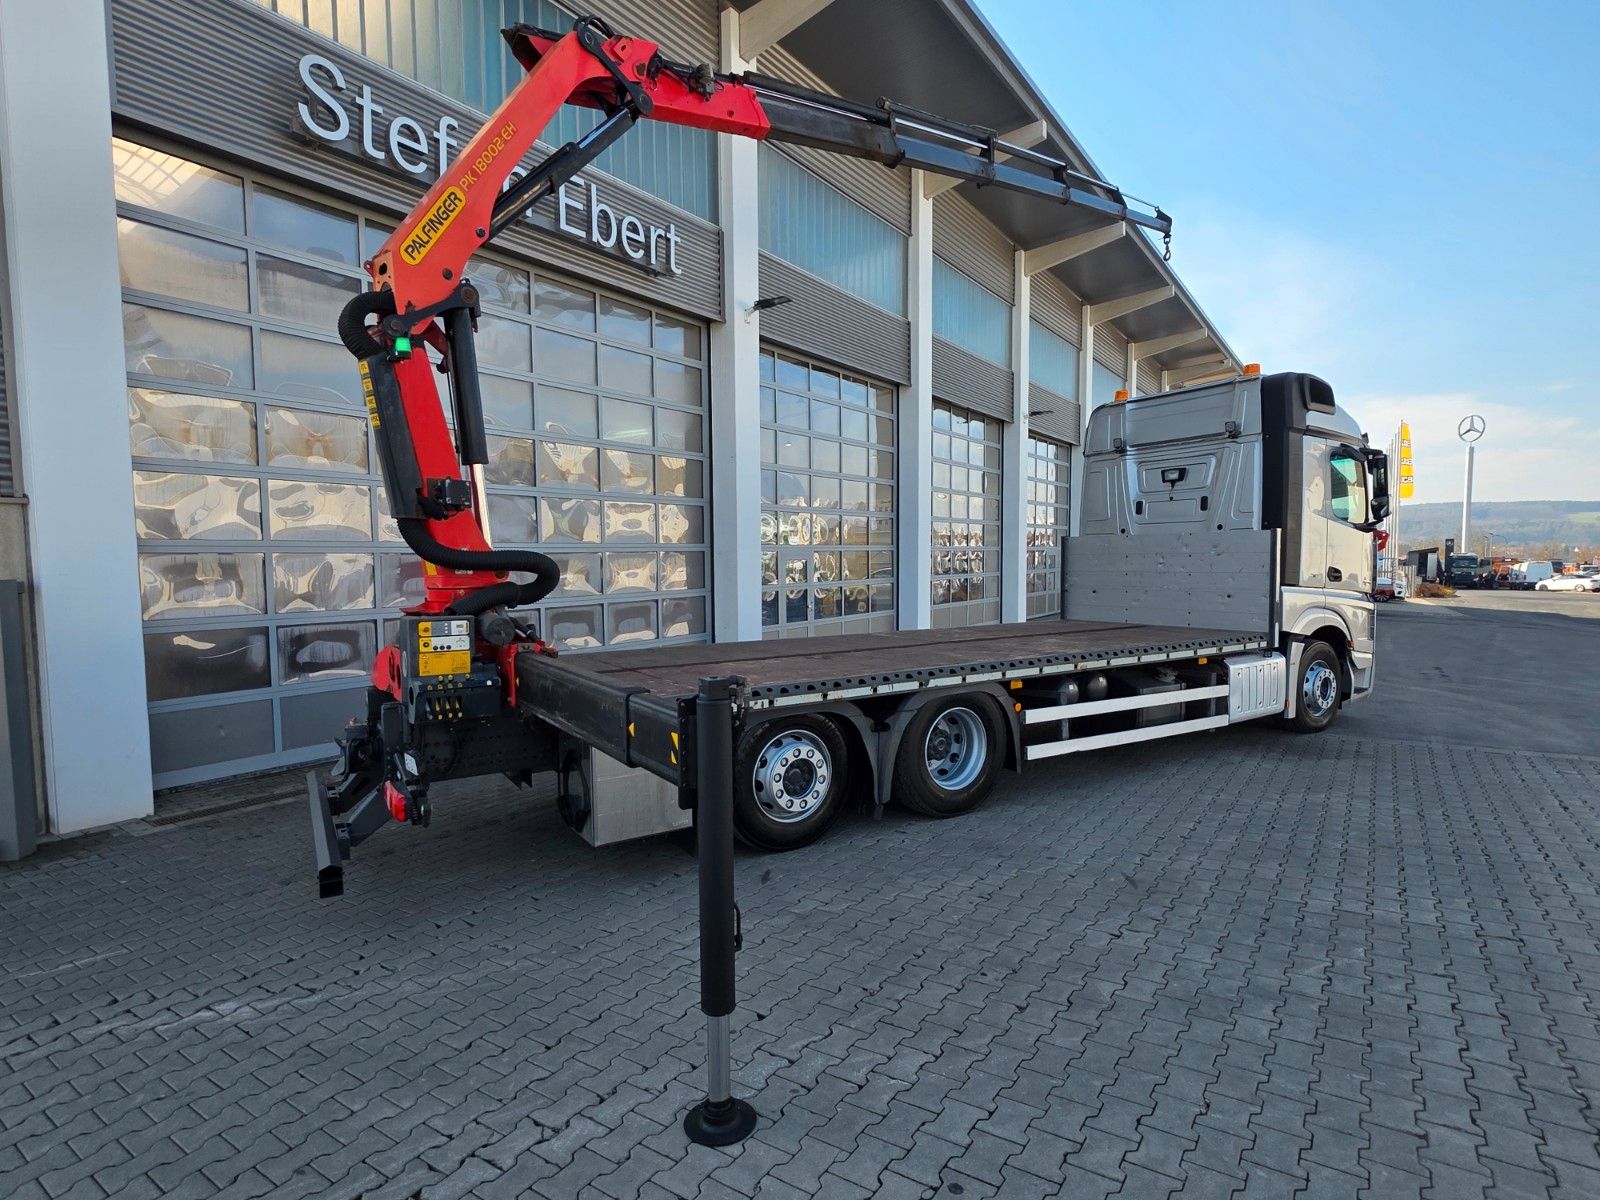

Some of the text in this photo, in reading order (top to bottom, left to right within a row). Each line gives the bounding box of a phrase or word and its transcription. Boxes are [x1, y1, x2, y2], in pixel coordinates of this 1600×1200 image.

[459, 171, 478, 192] PK
[403, 190, 463, 261] PALFINGER
[558, 175, 682, 275] Ebert
